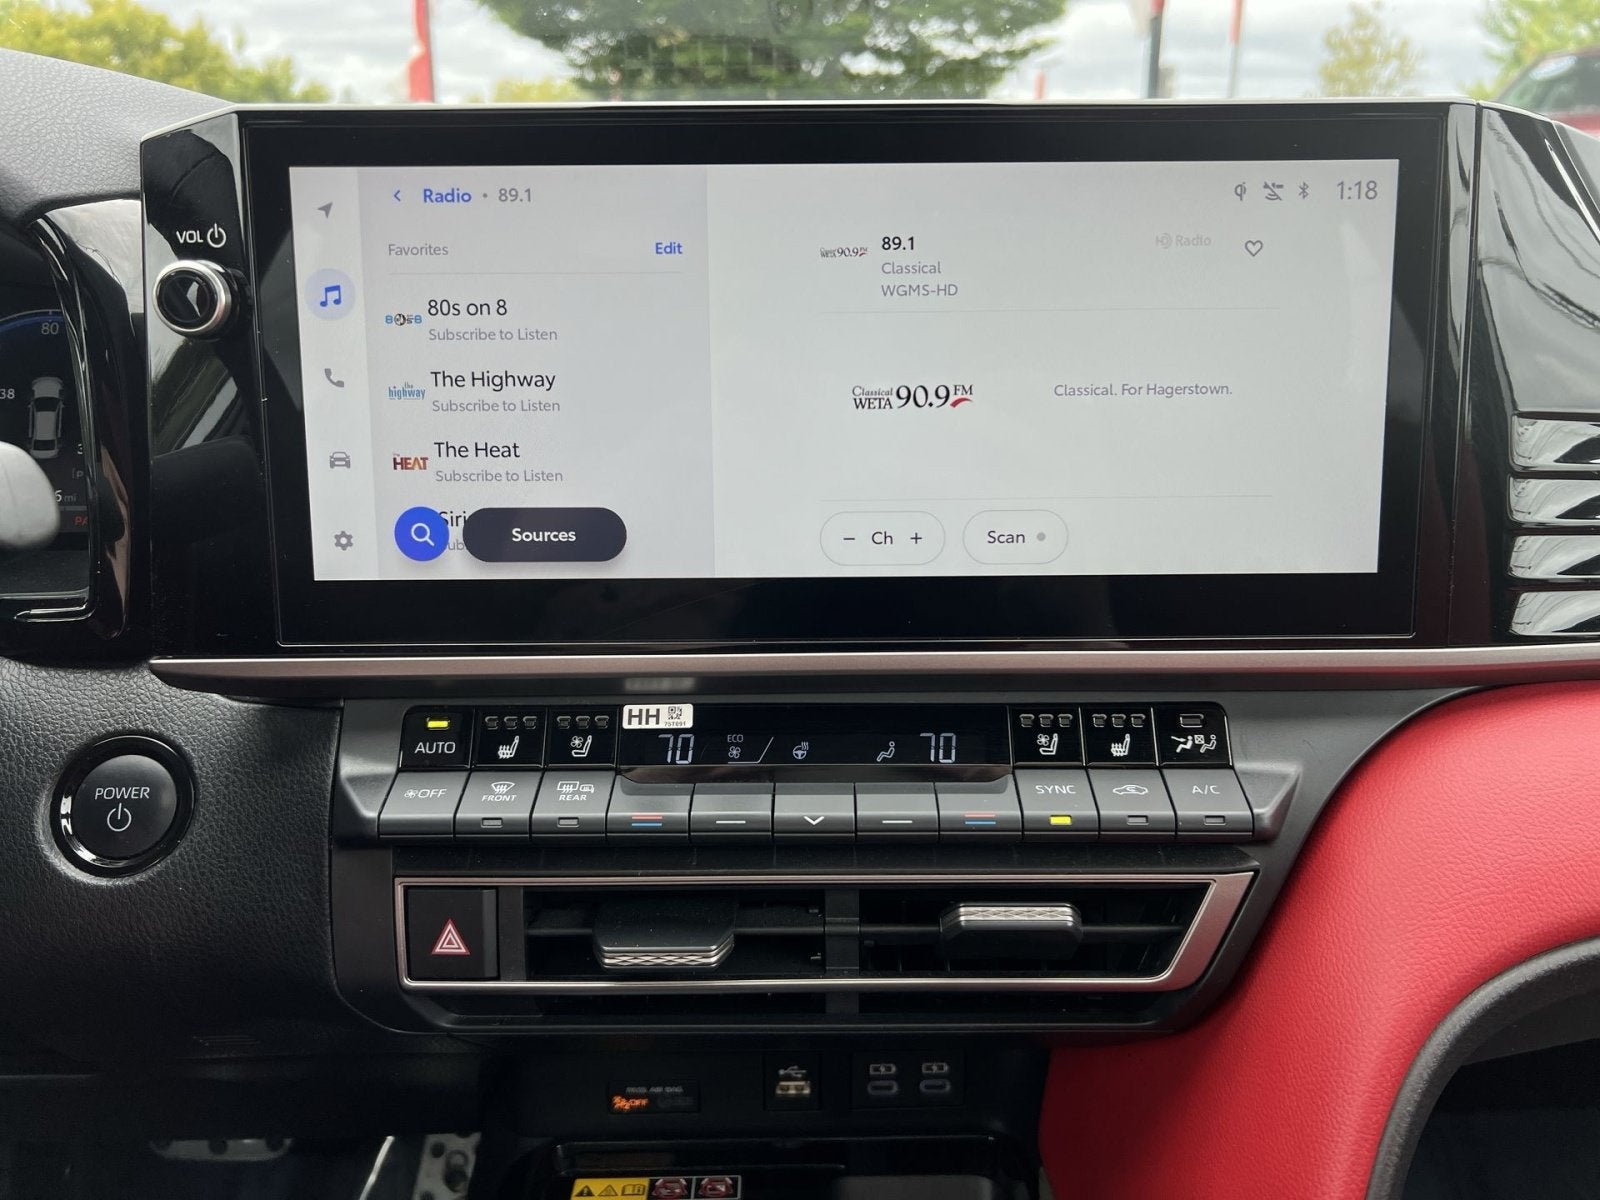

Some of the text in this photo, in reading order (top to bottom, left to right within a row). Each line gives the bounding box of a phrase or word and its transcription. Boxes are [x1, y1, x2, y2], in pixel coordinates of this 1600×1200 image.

[424, 188, 532, 203] Radio 89.1
[1337, 180, 1378, 200] 1:18
[176, 230, 203, 244] VOL
[882, 236, 914, 250] 89.1
[1175, 234, 1212, 248] Radio
[388, 243, 449, 256] Favorites
[655, 242, 683, 254] Edit
[881, 261, 942, 274] Classical
[881, 284, 959, 296] WGMS-HD
[428, 299, 508, 316] 80s on 8
[41, 323, 59, 335] 80
[428, 328, 558, 341] Subscribe to Listen
[431, 371, 556, 391] The Highway
[388, 386, 426, 400] highway
[852, 386, 893, 397] Classical
[896, 385, 950, 408] 90.9
[954, 385, 973, 395] FM
[1054, 384, 1232, 400] Classical. For Hagerstown.
[432, 400, 561, 412] Subscribe to Listen
[853, 398, 893, 409] WETA
[434, 441, 521, 458] The Heat
[392, 457, 428, 470] HEAT
[435, 470, 563, 482] Subscribe to Listen
[512, 528, 576, 542] Sources
[871, 531, 894, 545] Ch
[987, 531, 1026, 544] Scan
[628, 708, 660, 725] HH
[727, 734, 744, 742] ECO
[415, 742, 456, 754] AUTO
[658, 734, 695, 764] 70
[920, 733, 957, 763] 70
[95, 787, 150, 799] POWER
[418, 789, 447, 798] OFF
[1036, 785, 1076, 795] SYNC
[1192, 785, 1221, 794] A/C
[481, 794, 517, 802] FRONT
